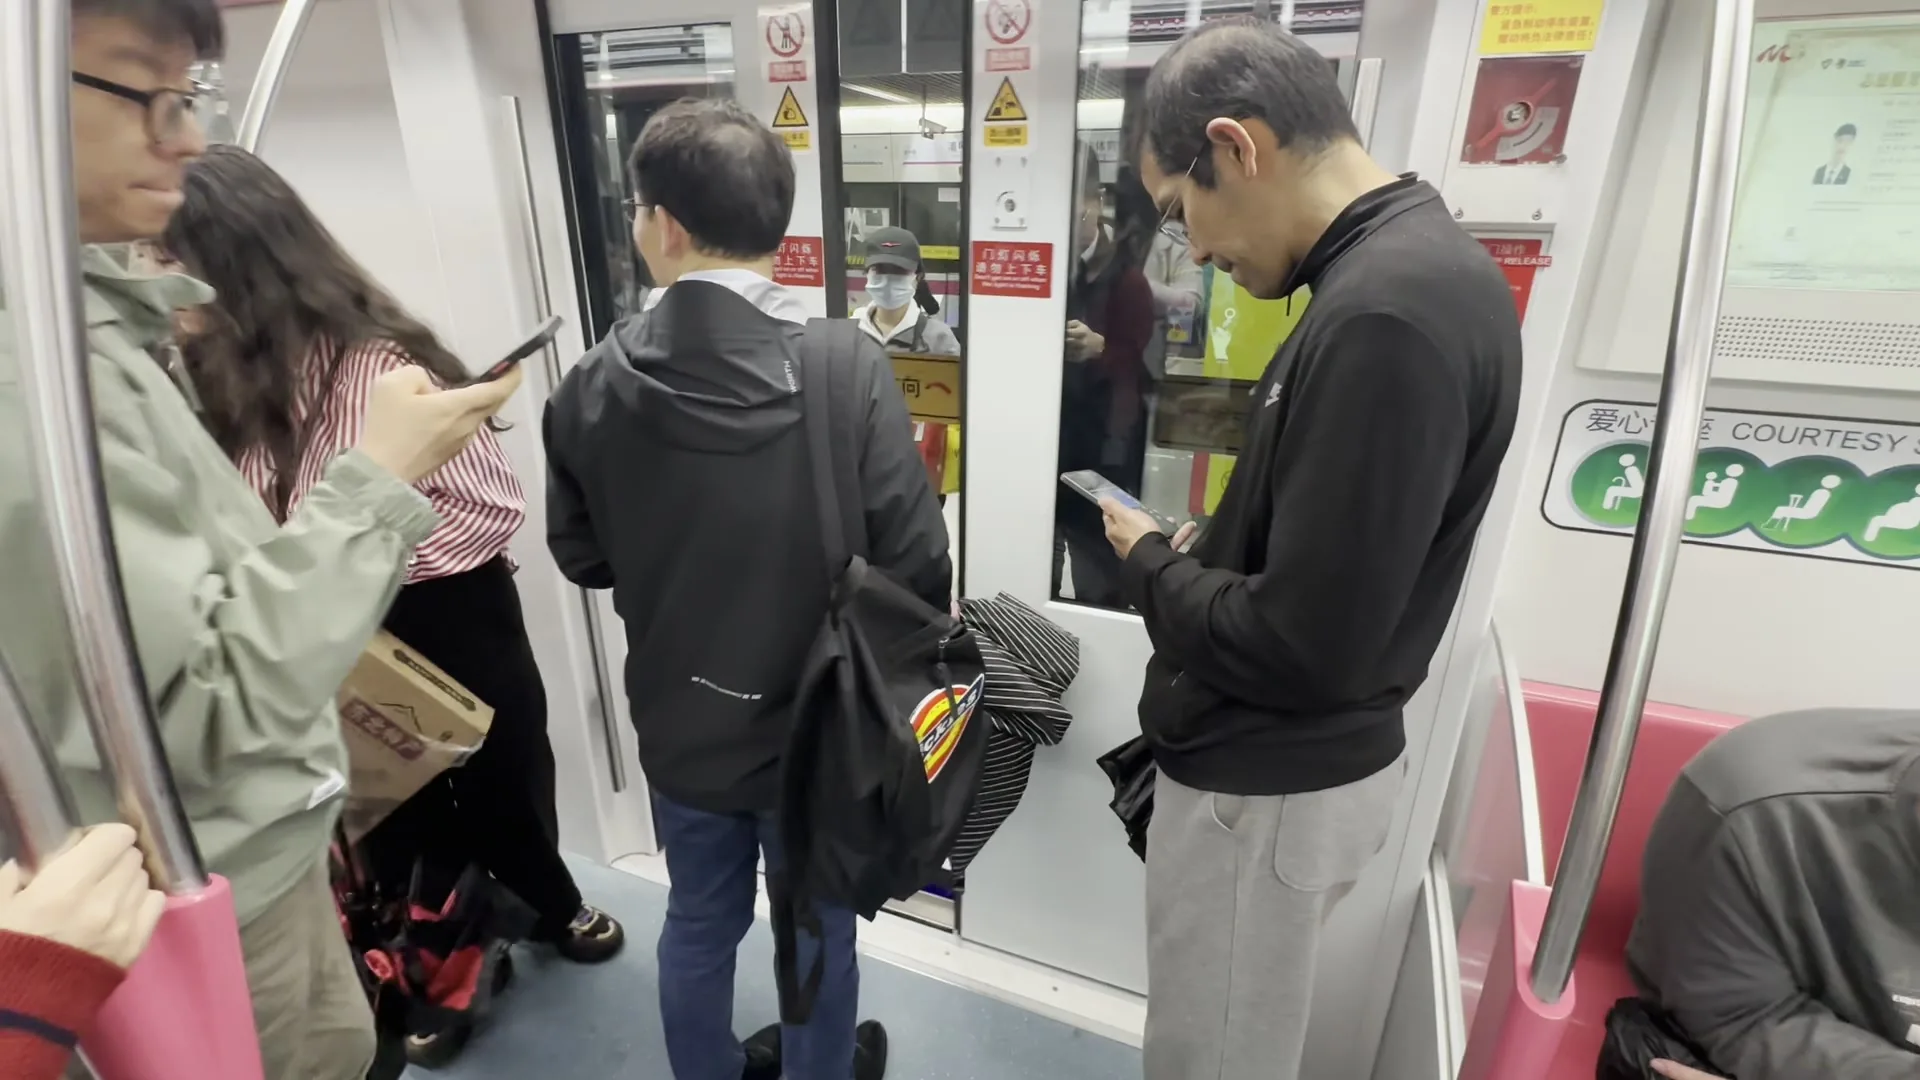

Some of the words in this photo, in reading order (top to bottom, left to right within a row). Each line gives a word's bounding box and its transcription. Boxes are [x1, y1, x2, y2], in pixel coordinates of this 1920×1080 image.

[1504, 257, 1551, 265] RELEASE
[1586, 408, 1715, 440] 爱心
[1732, 422, 1907, 453] COURTESY
